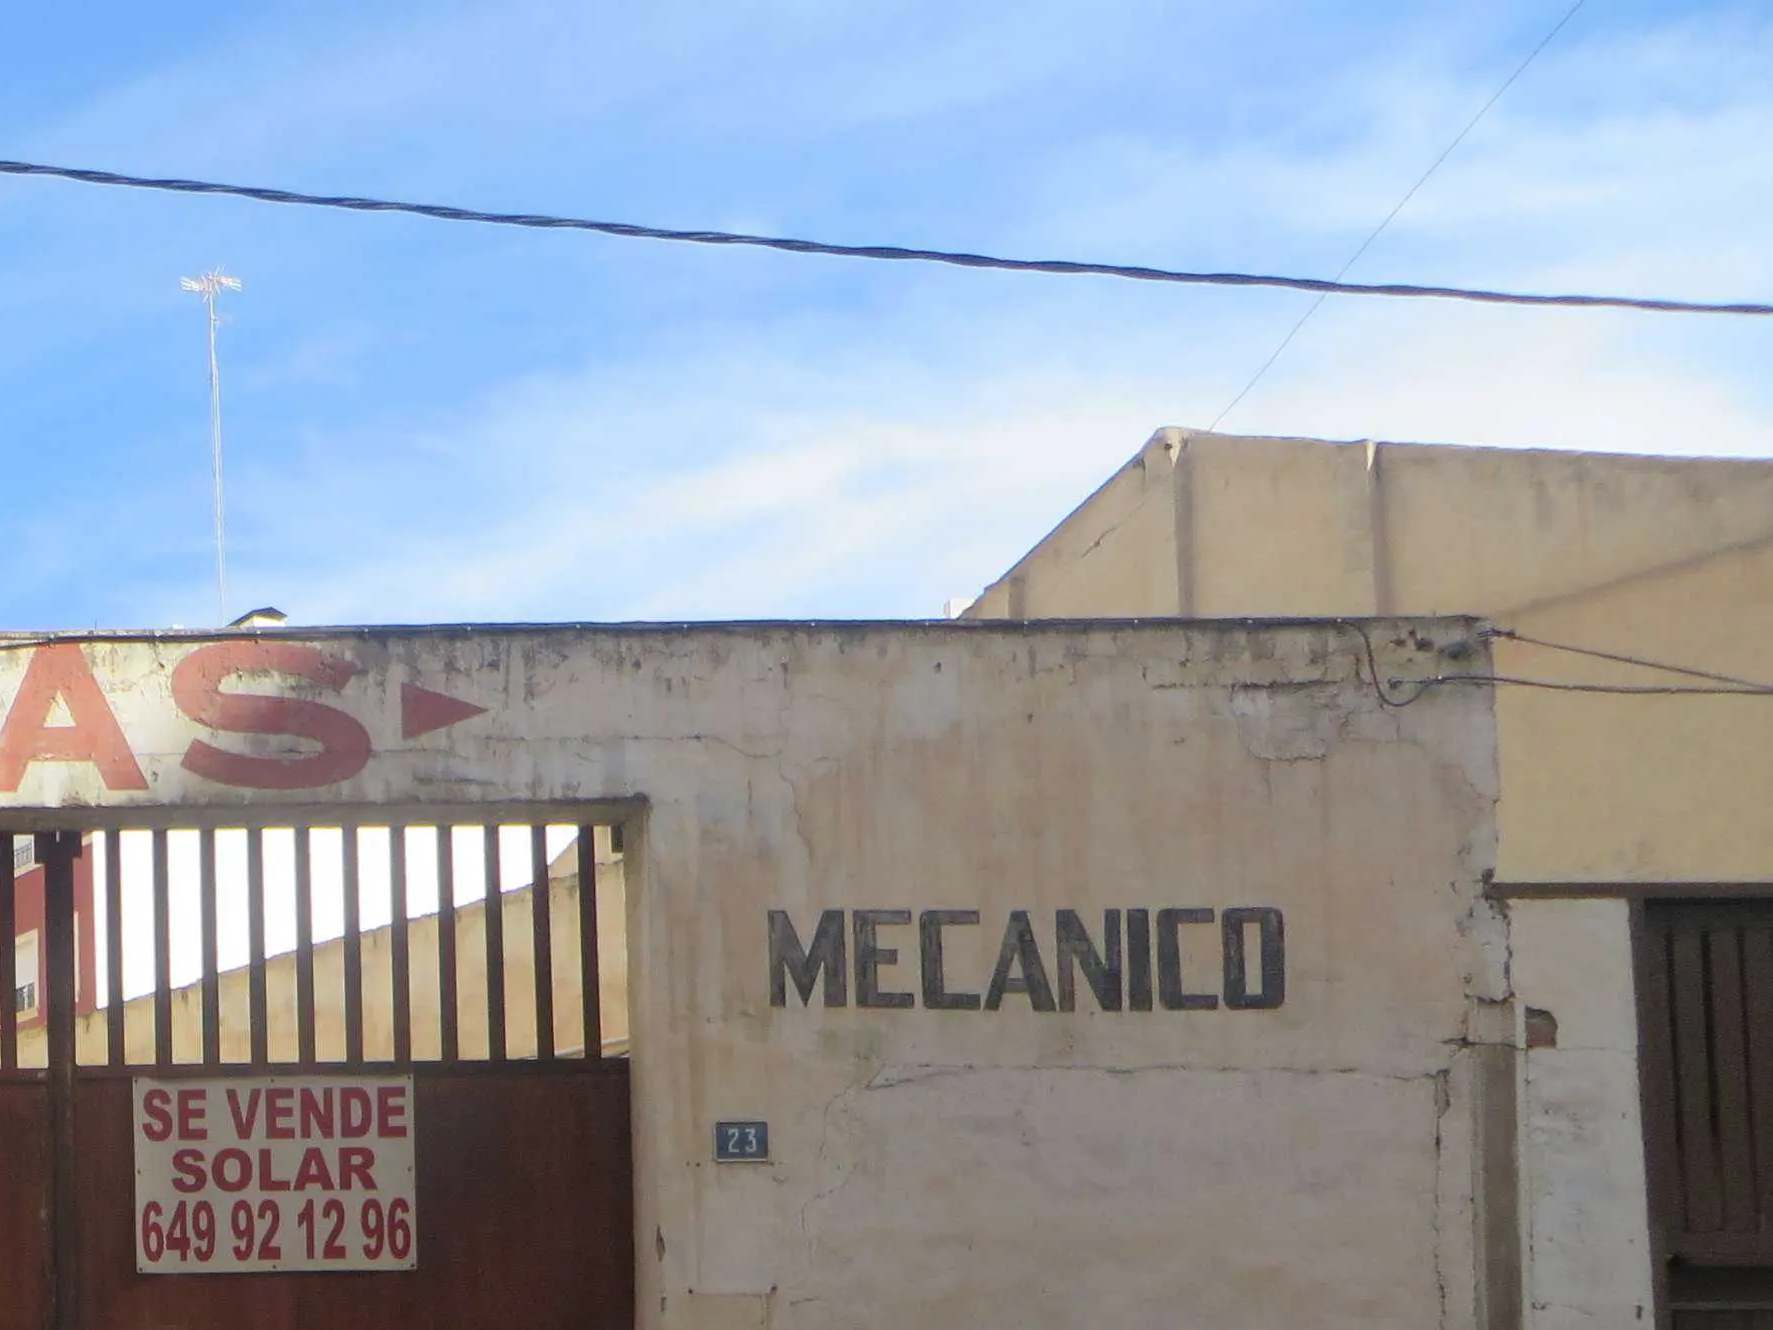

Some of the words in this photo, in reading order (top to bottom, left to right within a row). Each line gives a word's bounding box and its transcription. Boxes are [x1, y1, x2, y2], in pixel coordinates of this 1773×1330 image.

[767, 907, 1285, 1012] MECANICO
[142, 1088, 208, 1141] SE
[226, 1086, 408, 1140] VENDE
[726, 1128, 758, 1155] 23
[171, 1147, 378, 1193] SOLAR
[142, 1200, 216, 1262] 649
[231, 1200, 281, 1261] 92
[297, 1199, 347, 1260] 12
[361, 1198, 411, 1260] 96
